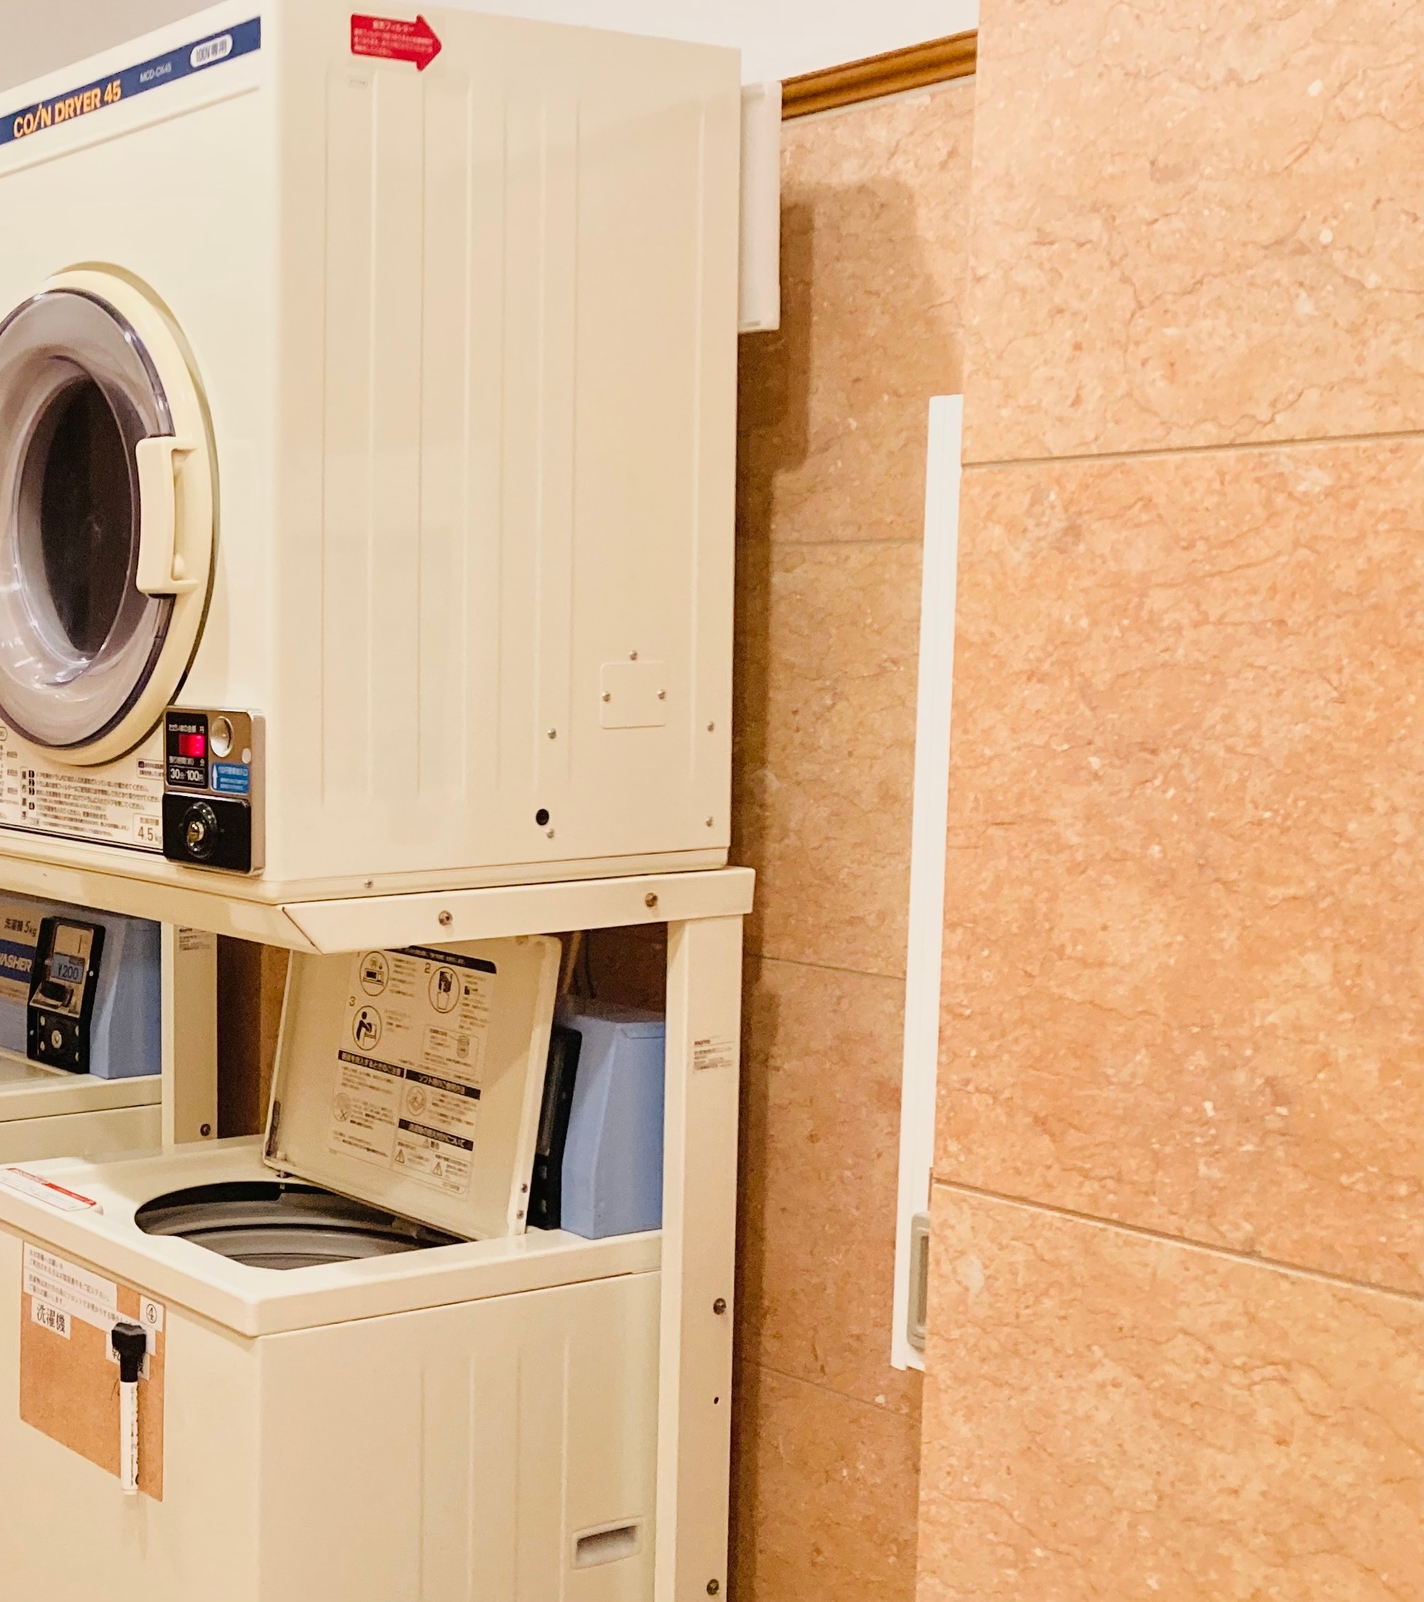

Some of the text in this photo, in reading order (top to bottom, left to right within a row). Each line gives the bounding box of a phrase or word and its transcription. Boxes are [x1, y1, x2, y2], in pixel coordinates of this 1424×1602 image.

[55, 87, 101, 123] DRYER
[104, 80, 122, 104] 45
[23, 920, 37, 937] 5kg
[36, 1302, 66, 1334] 洗濯機
